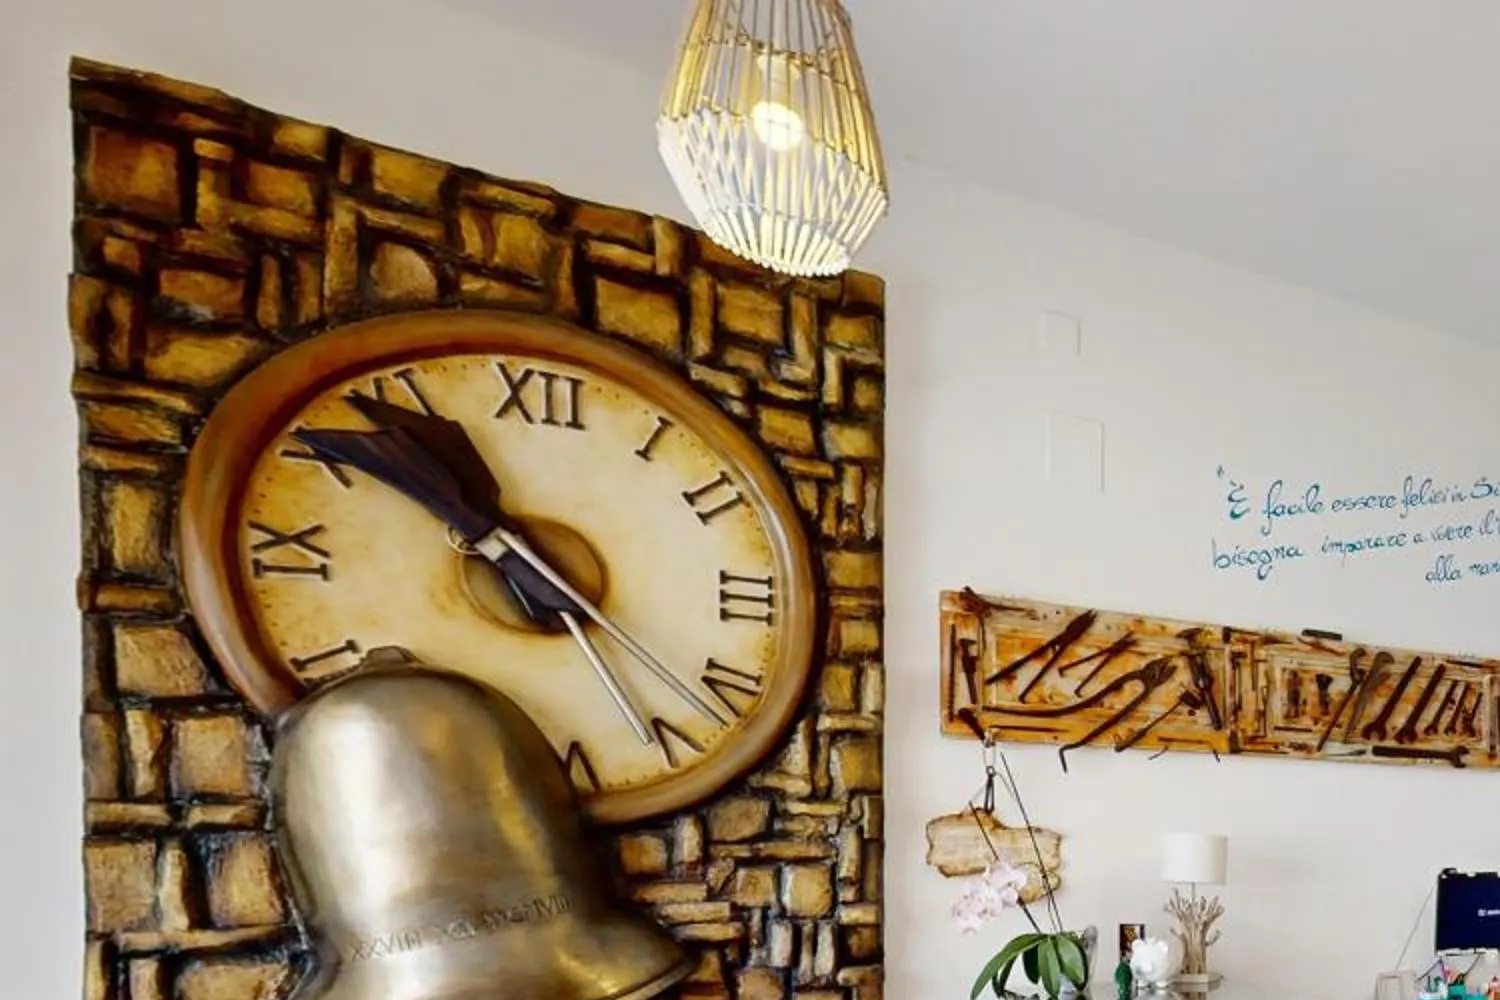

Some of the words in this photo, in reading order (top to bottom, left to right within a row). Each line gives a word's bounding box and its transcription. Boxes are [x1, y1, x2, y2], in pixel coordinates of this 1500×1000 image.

[494, 361, 587, 431] XII
[634, 414, 674, 462] I
[681, 470, 751, 527] II
[1260, 479, 1324, 537] facile
[1330, 494, 1397, 512] essere
[247, 520, 333, 582] IX
[1211, 536, 1304, 581] bisogna
[1321, 535, 1408, 568] imparare
[1424, 554, 1463, 582] alla
[718, 569, 774, 627] III
[700, 656, 765, 719] IV
[651, 716, 706, 770] V
